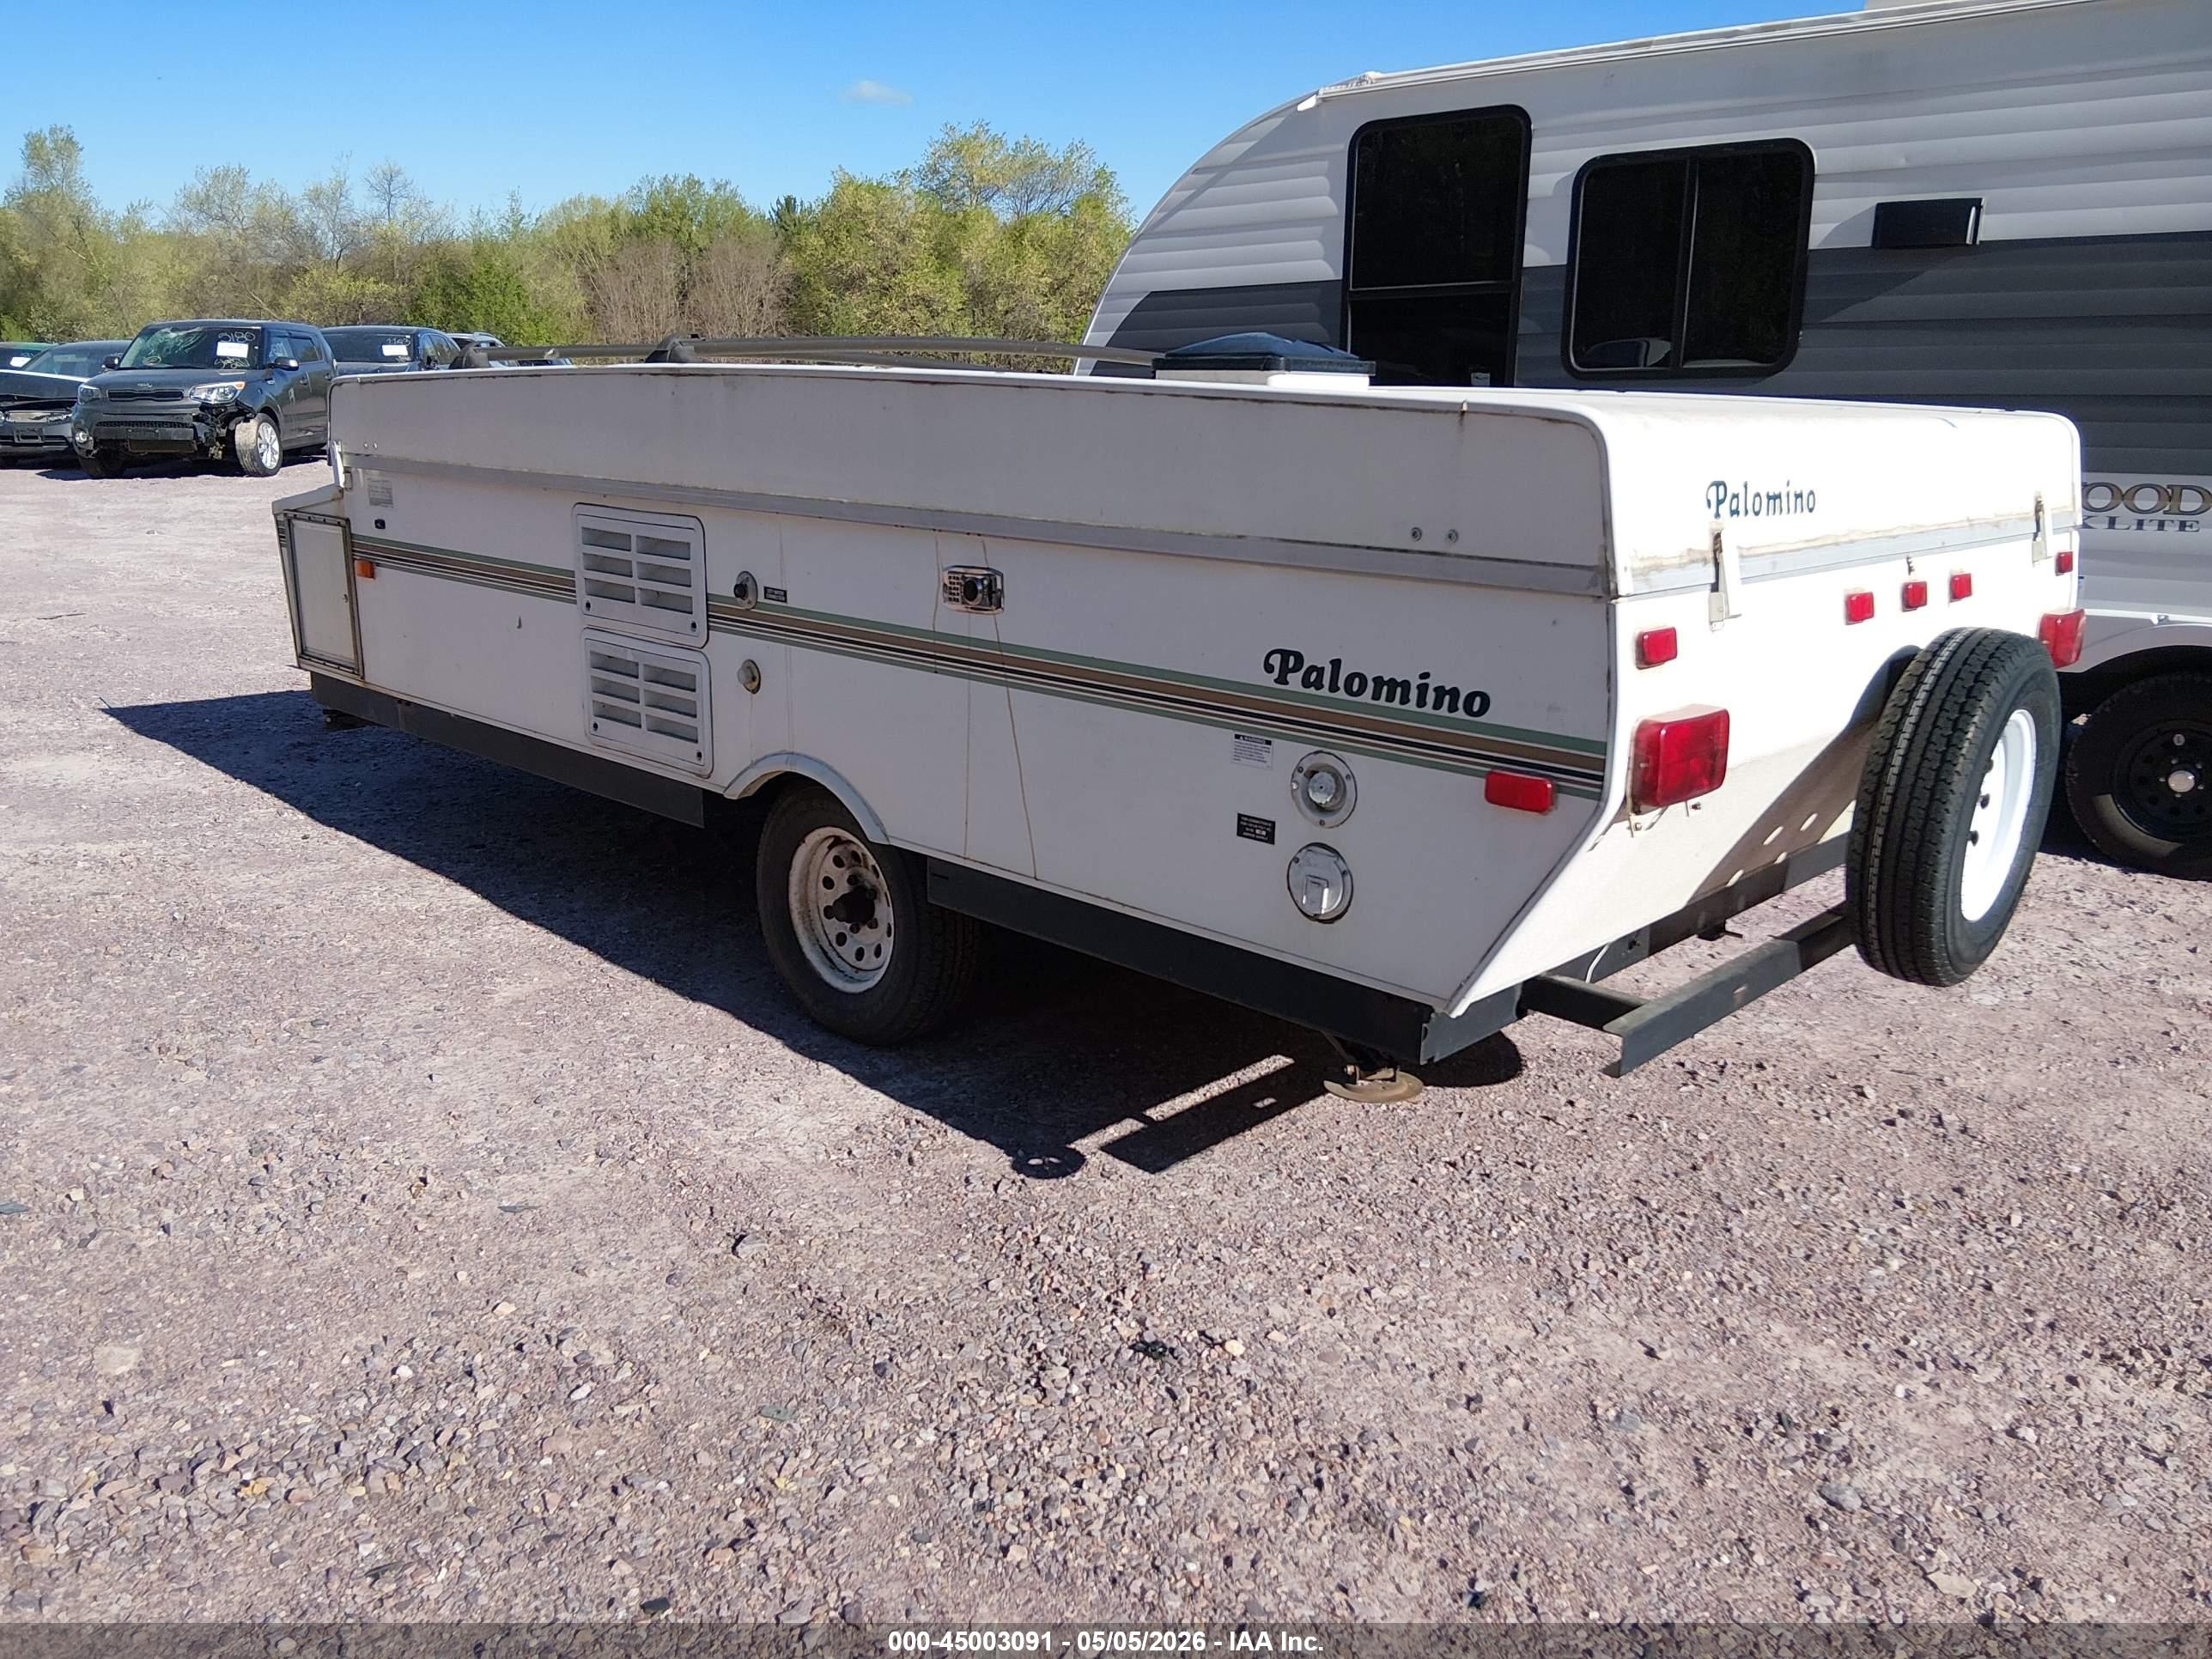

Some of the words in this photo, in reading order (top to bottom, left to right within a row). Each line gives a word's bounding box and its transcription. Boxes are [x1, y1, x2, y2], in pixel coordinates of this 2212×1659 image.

[1705, 480, 1817, 520] Palomino
[2081, 482, 2212, 516] OOD
[1263, 648, 1491, 718] Palomino
